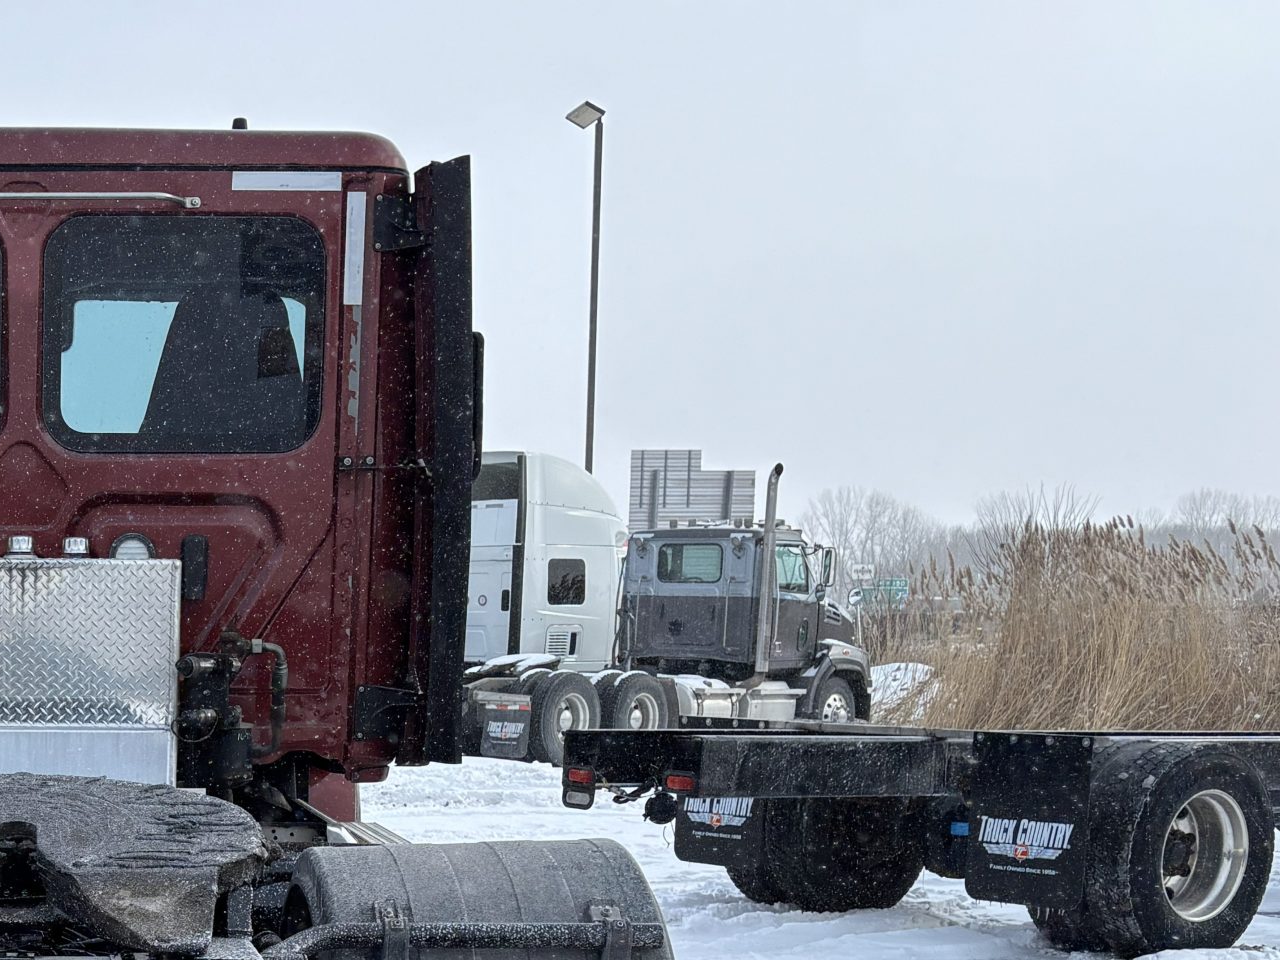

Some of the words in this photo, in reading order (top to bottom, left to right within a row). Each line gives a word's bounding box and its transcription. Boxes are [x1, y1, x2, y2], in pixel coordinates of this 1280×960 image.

[683, 797, 711, 813] TRUCK
[712, 797, 754, 817] COUNTRY
[978, 815, 1017, 844] TRUCK
[1016, 818, 1074, 849] COUNTRY
